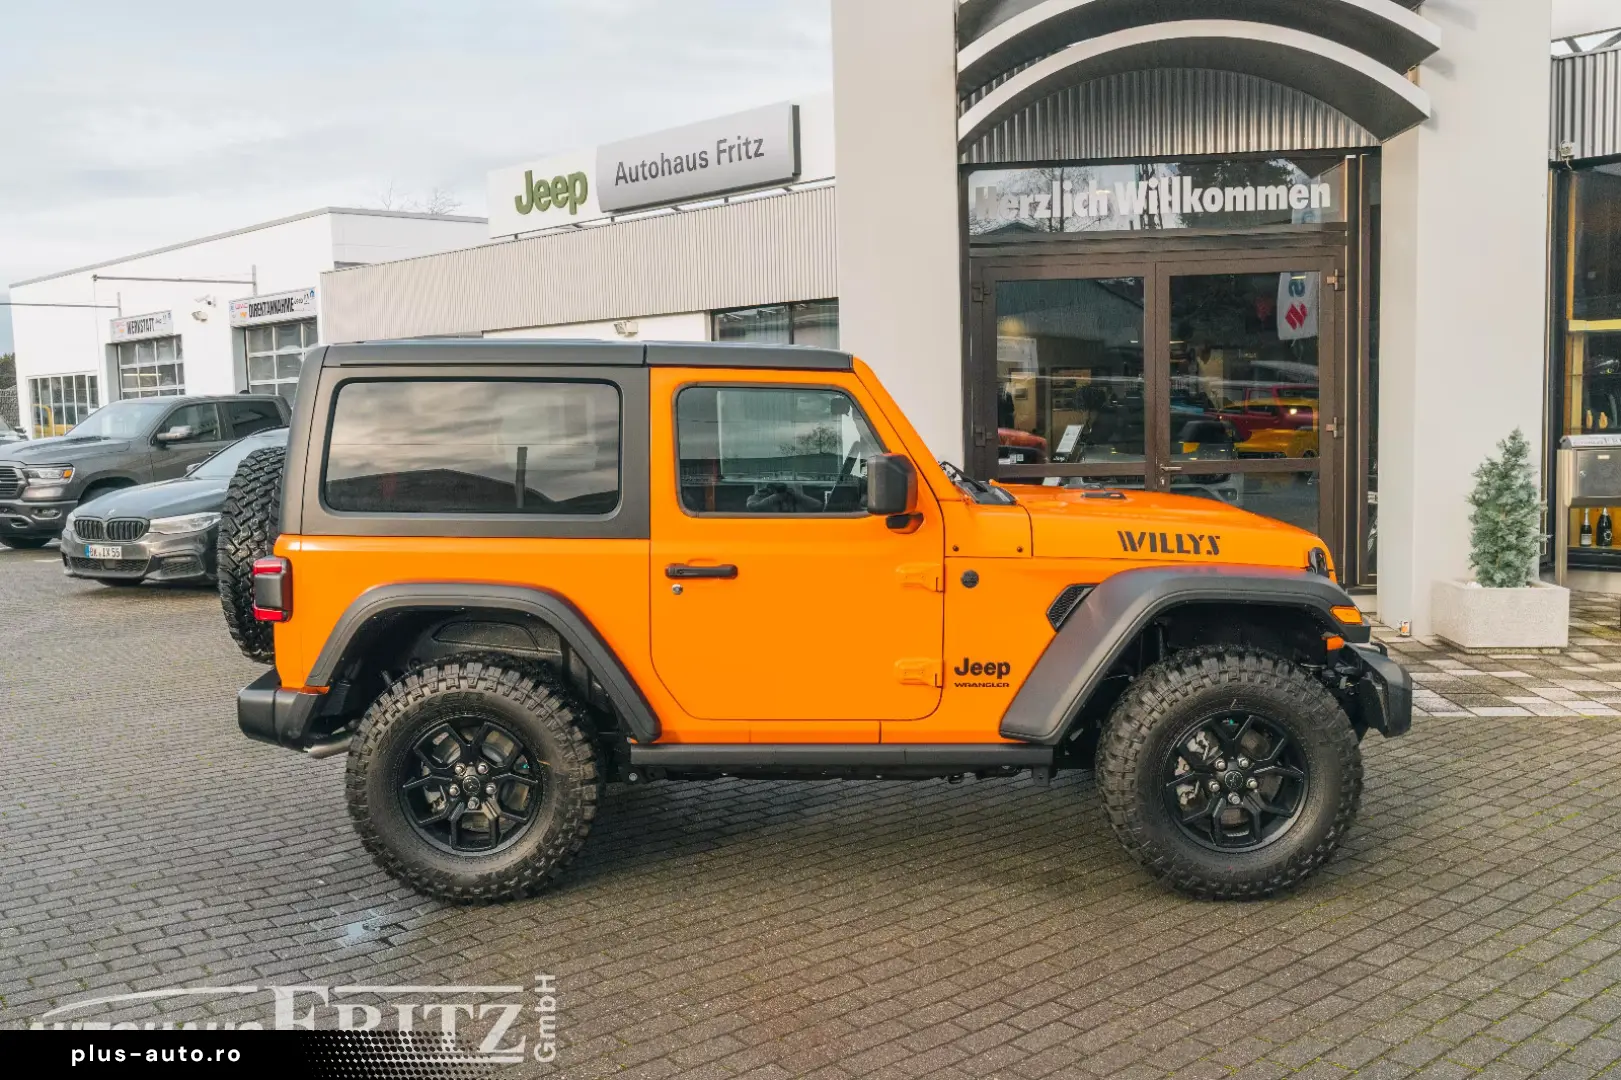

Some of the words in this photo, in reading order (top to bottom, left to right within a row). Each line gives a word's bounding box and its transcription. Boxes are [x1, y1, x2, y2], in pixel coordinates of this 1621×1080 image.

[614, 149, 709, 186] Autohaus
[715, 135, 765, 165] Fritz
[514, 169, 588, 215] Jeep
[975, 179, 1109, 219] Herzlich
[1114, 175, 1331, 215] Willkommen
[126, 317, 155, 335] WERKSTATT
[1117, 530, 1221, 556] WILLYS
[954, 656, 1011, 680] Jeep
